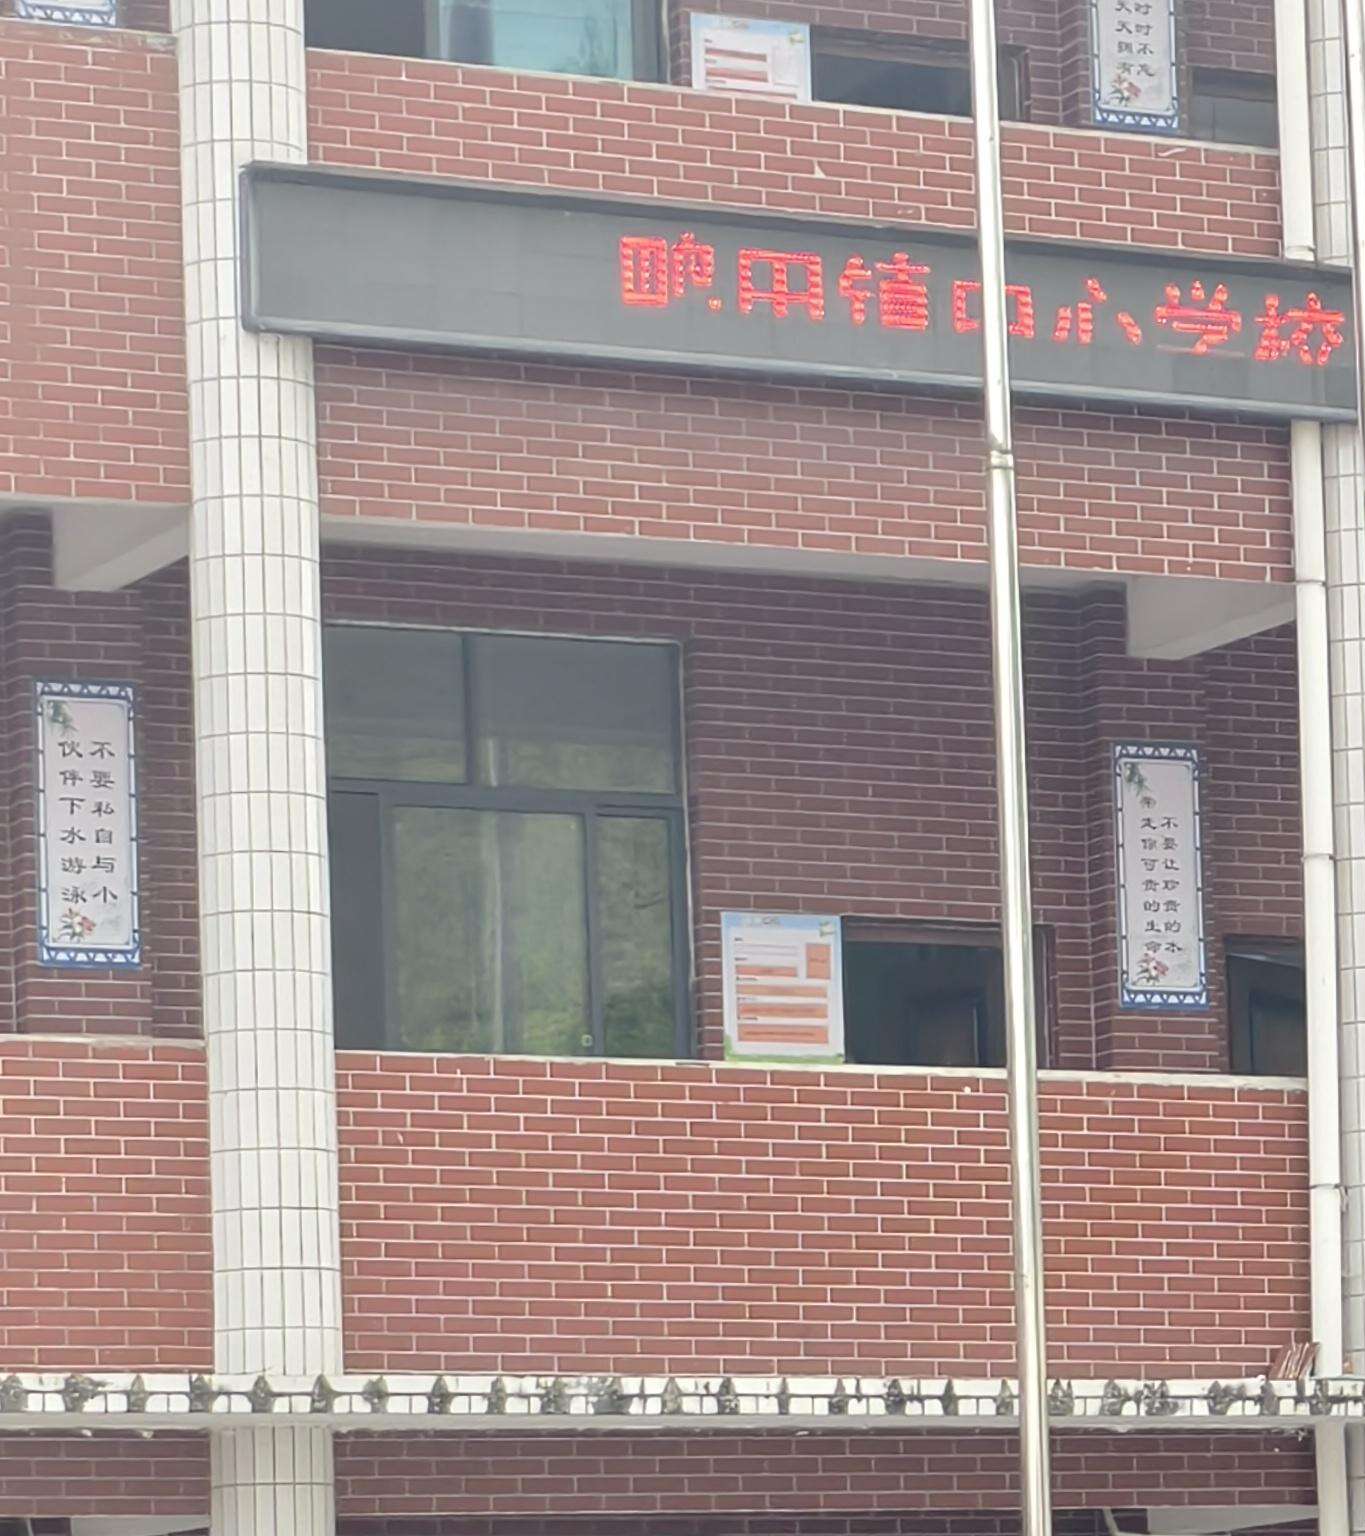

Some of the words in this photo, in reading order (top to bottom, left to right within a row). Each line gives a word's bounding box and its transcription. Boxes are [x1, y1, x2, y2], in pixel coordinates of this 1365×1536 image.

[57, 738, 88, 906] 伙伴下水游泳
[88, 739, 119, 906] 不要私自与小
[1160, 815, 1184, 955] 不要让珍贵的水
